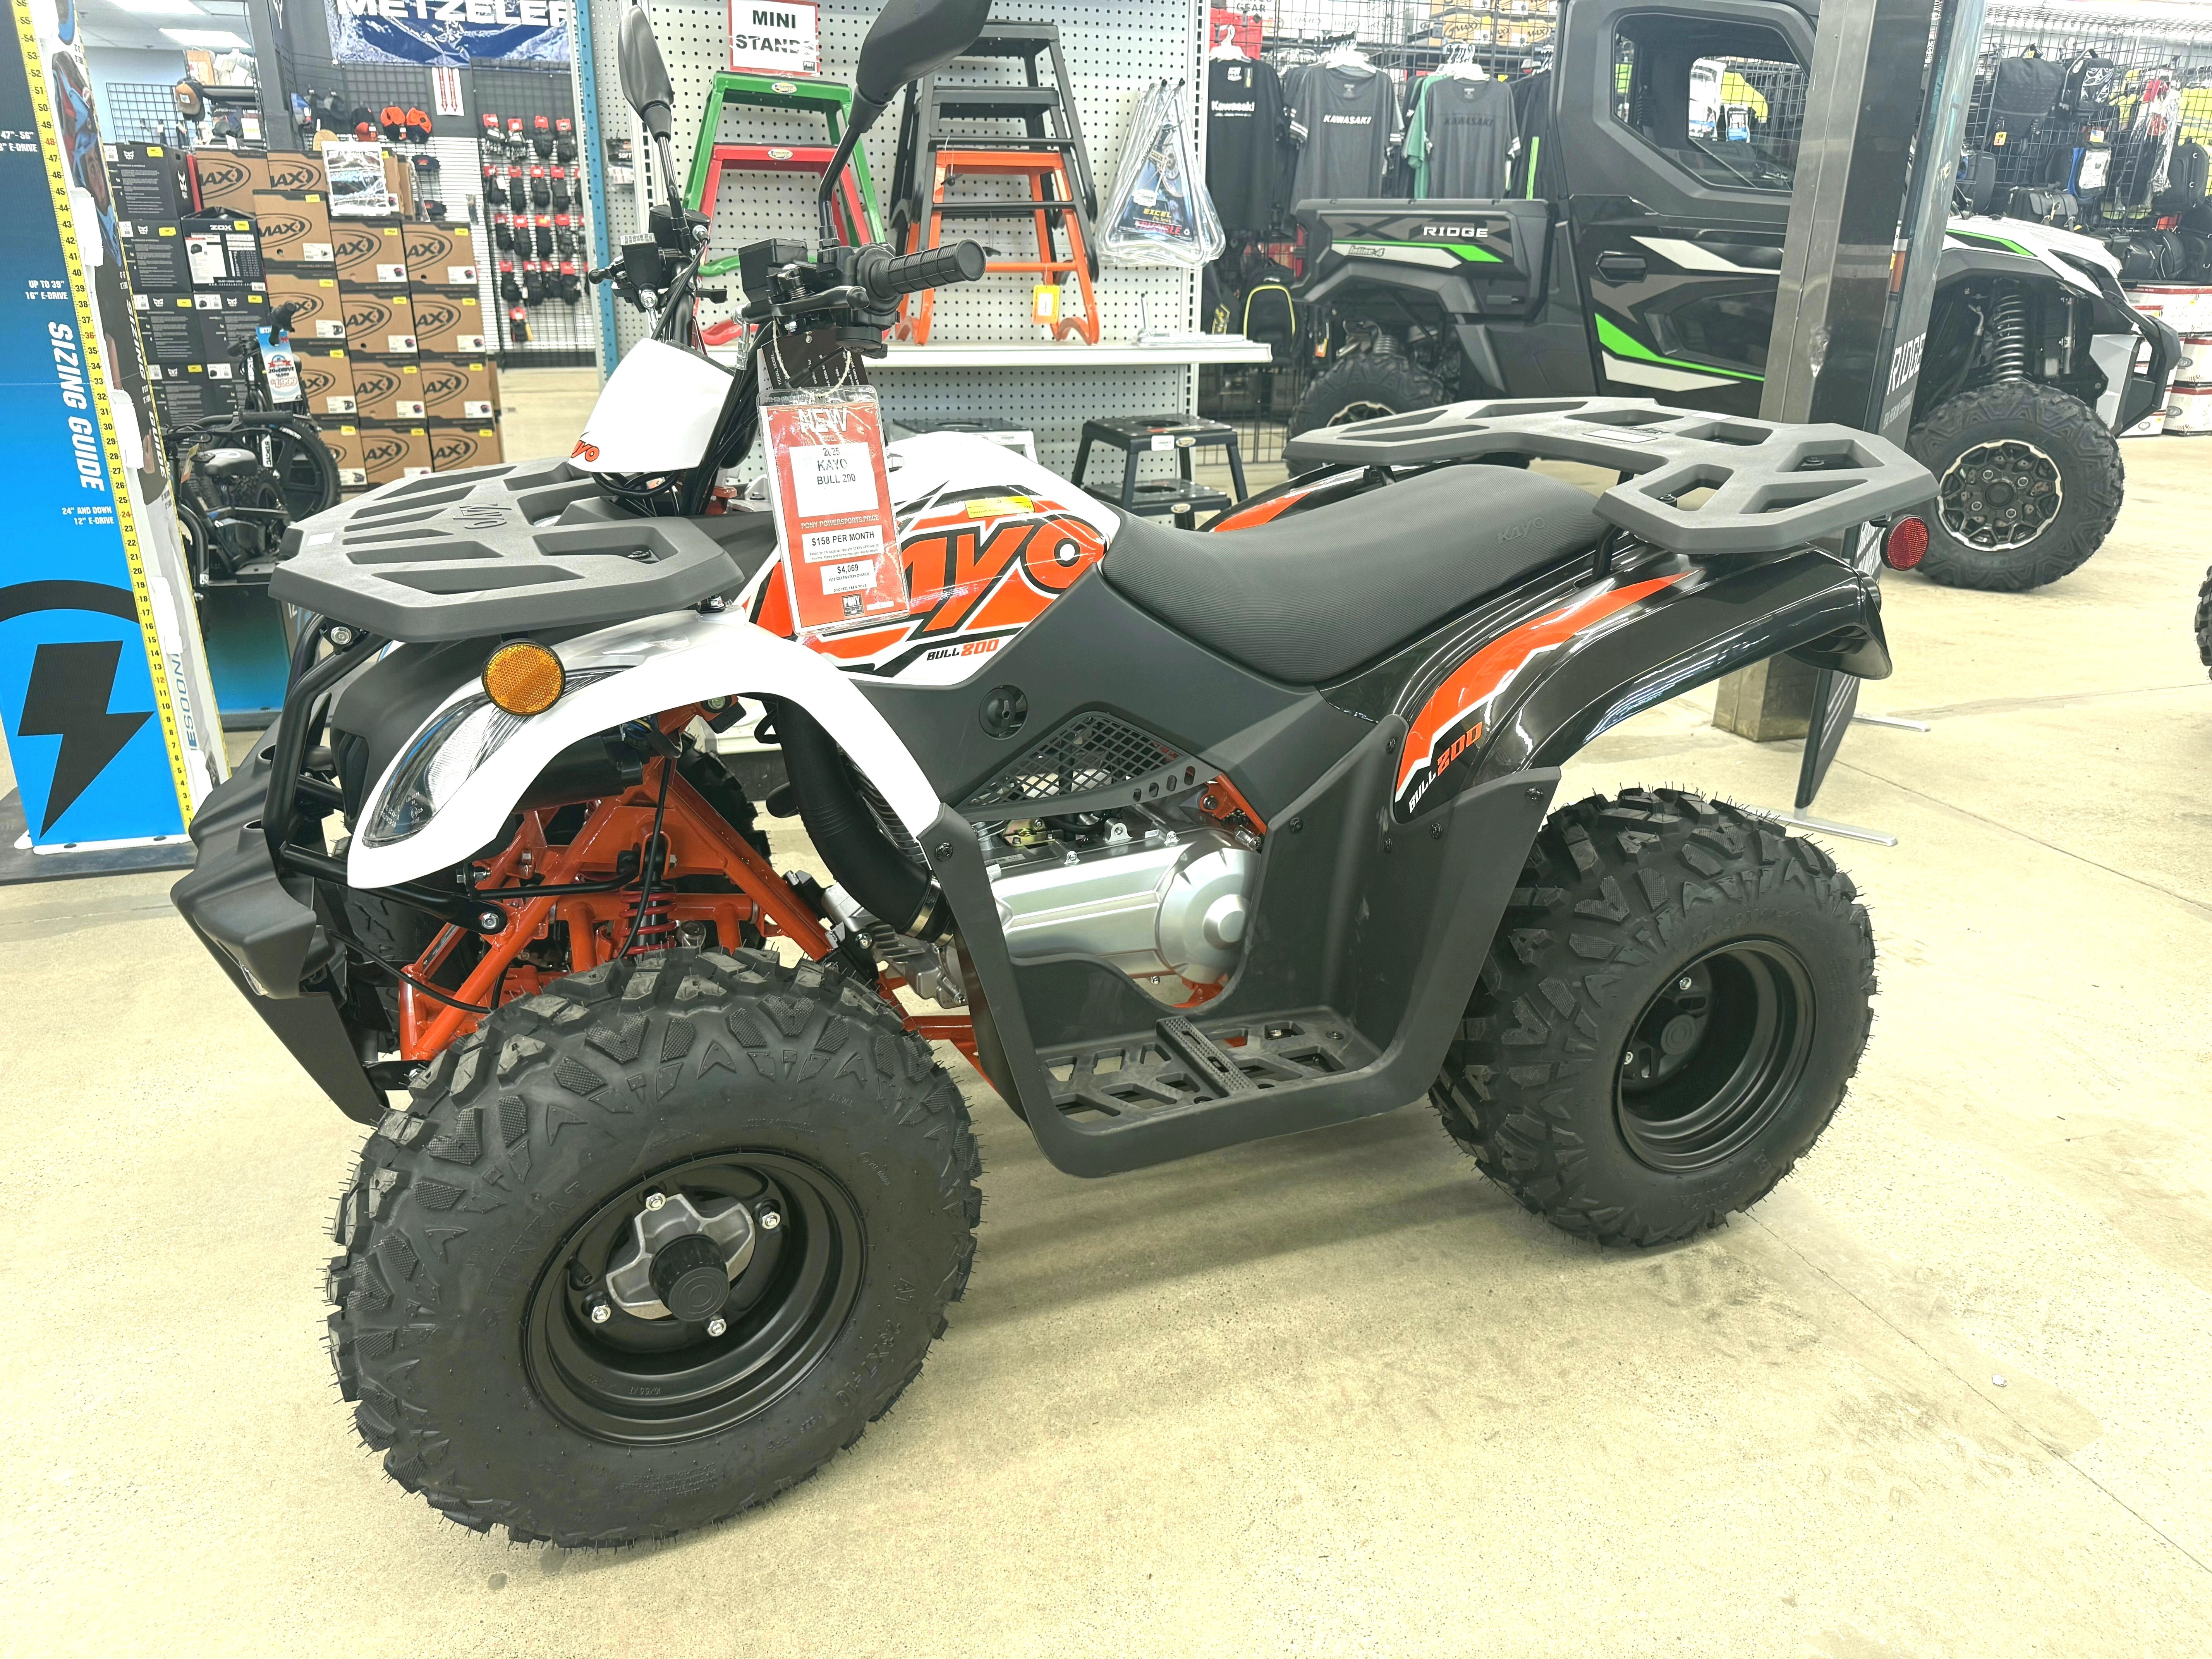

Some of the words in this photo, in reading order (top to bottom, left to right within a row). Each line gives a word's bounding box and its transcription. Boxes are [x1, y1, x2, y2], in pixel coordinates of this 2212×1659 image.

[753, 10, 795, 29] MINI
[1211, 100, 1255, 112] Kawasaki
[1323, 115, 1372, 124] KAWASAKI
[9, 142, 38, 152] E-DRIVE
[1143, 208, 1172, 218] EXCEL
[1423, 227, 1488, 237] RIDGE
[28, 280, 39, 288] UP
[40, 280, 49, 288] TO
[51, 280, 64, 288] 39"
[25, 291, 39, 300] 16"
[41, 291, 68, 300] E-DRIVE
[126, 299, 146, 380] SIZING
[48, 321, 87, 410] SIZING
[1887, 332, 1926, 396] RIDGE
[798, 407, 848, 433] NEW
[148, 411, 166, 479] GUIDE
[68, 416, 105, 491] GUIDE
[817, 459, 848, 472] KAYO
[817, 475, 840, 485] BULL
[842, 473, 856, 483] 200
[77, 507, 91, 515] AND
[92, 506, 112, 514] DOWN
[88, 516, 115, 524] E-DRIVE
[1497, 517, 1546, 543] KAYO
[811, 536, 830, 546] $158
[832, 534, 848, 543] PER
[849, 531, 874, 541] MONTH
[837, 563, 859, 574] $4,069
[842, 595, 861, 608] PONY
[926, 648, 960, 661] BULL
[960, 639, 1000, 656] 200
[1408, 770, 1438, 814] BULL
[1437, 721, 1483, 777] 200
